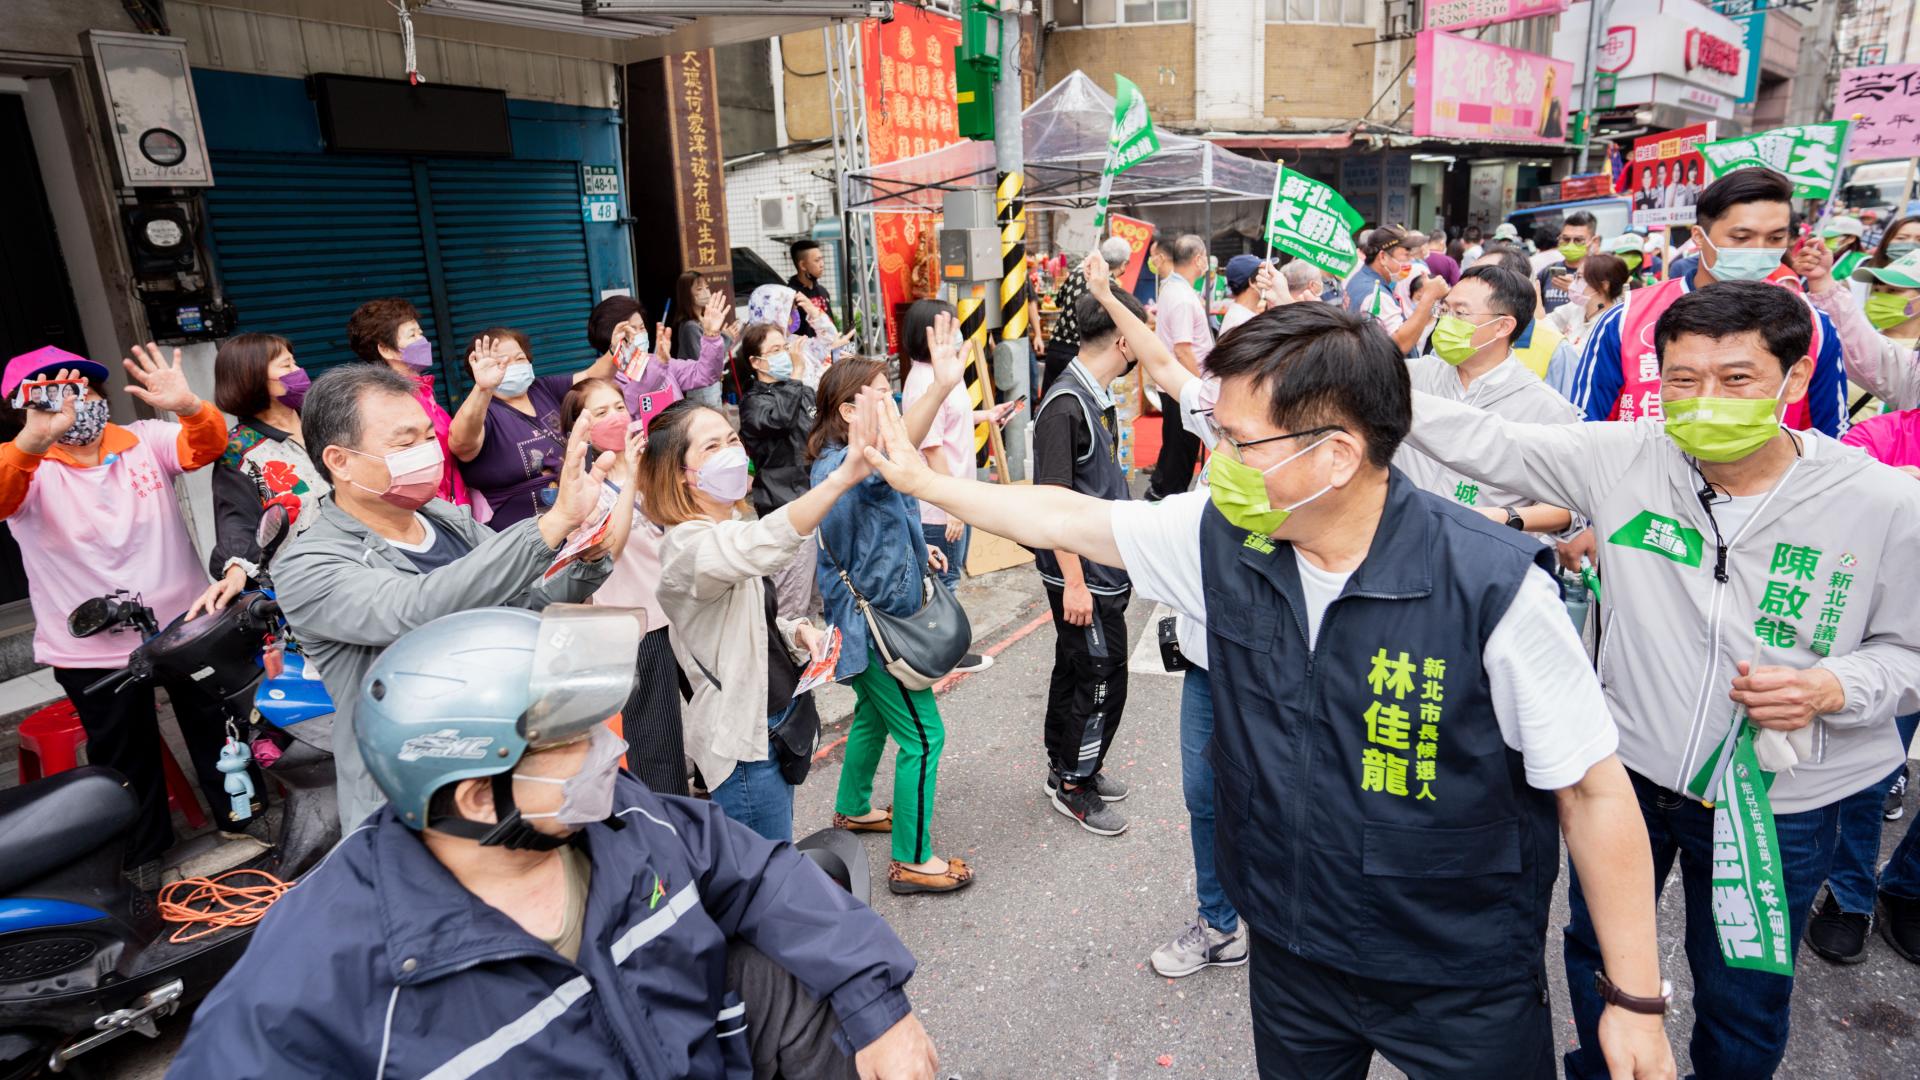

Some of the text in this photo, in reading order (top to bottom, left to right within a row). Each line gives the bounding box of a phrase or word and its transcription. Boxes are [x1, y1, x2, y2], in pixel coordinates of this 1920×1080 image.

[598, 205, 611, 218] 48
[1280, 175, 1333, 210] 新北
[1809, 571, 1854, 658] 新北市議員
[1361, 648, 1417, 797] 林佳龍
[1415, 657, 1446, 801] 新北市長候選人
